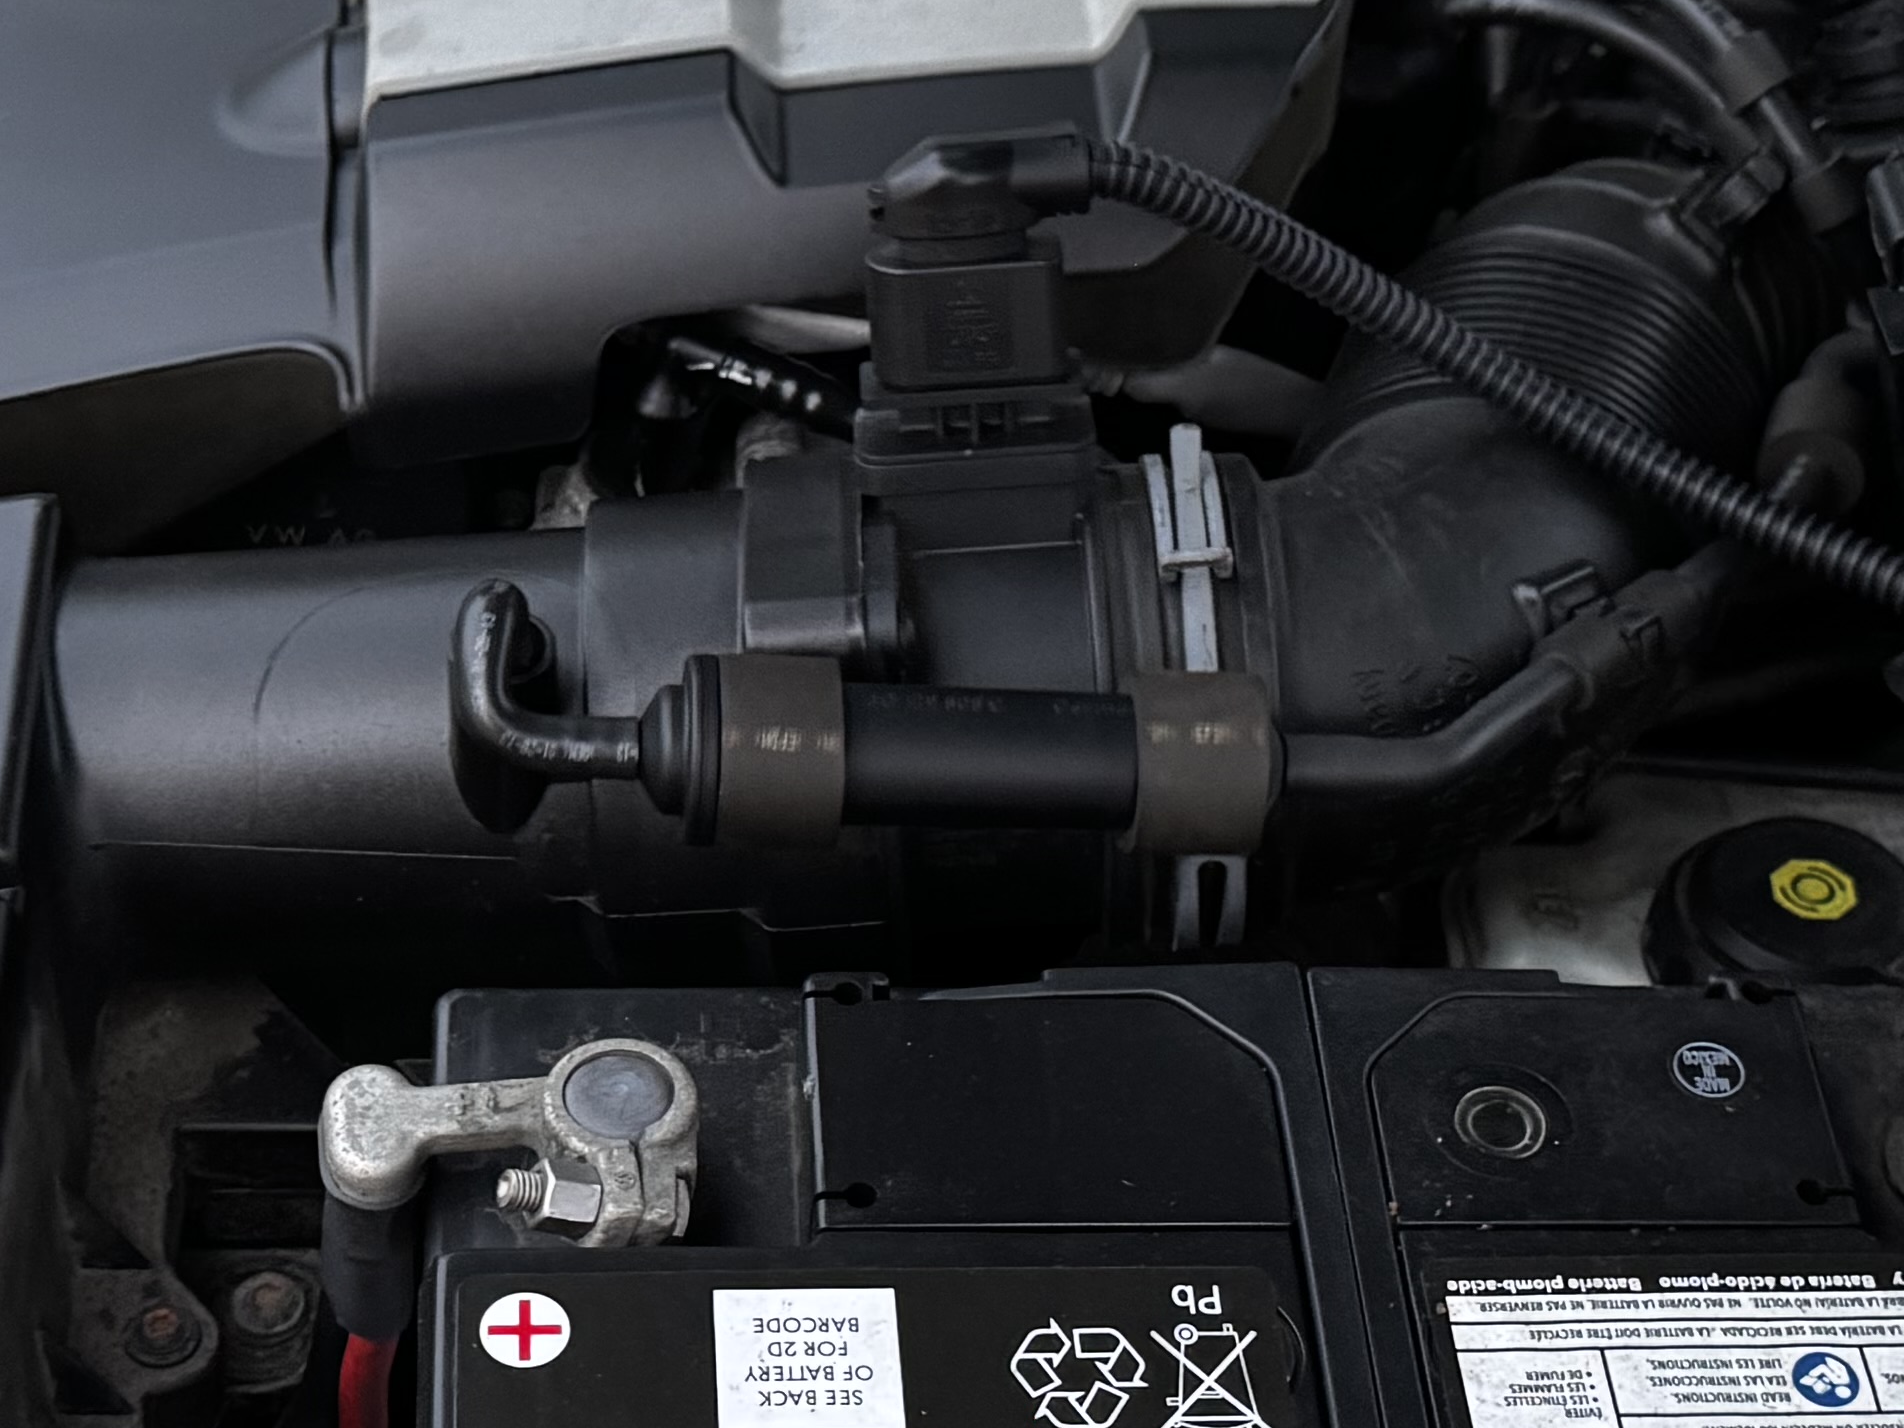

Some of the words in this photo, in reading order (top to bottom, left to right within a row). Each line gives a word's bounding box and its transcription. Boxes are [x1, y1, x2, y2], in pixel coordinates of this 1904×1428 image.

[1444, 1273, 1565, 1292] plomb-acide
[1566, 1276, 1642, 1291] Batterie
[1656, 1271, 1778, 1290] ácido-plomo
[1777, 1274, 1806, 1287] de
[1806, 1274, 1877, 1288] Batería
[1171, 1283, 1223, 1315] Pb
[753, 1318, 858, 1333] BARCODE
[768, 1342, 796, 1356] 2D
[804, 1342, 847, 1356] FOR
[1734, 1358, 1755, 1368] LES
[1756, 1358, 1782, 1368] LIRE
[745, 1366, 834, 1381] BATTERY
[844, 1365, 873, 1380] OF
[1524, 1371, 1565, 1380] FUMER
[1566, 1370, 1582, 1379] DE
[1742, 1374, 1764, 1385] LAS
[1508, 1383, 1564, 1393] FLAMMES
[1566, 1382, 1586, 1392] LES
[759, 1390, 816, 1406] BACK
[826, 1390, 862, 1405] SEE
[1569, 1395, 1589, 1405] LES
[1670, 1391, 1758, 1402] INSTRUCTIONS.
[1759, 1391, 1791, 1402] READ
